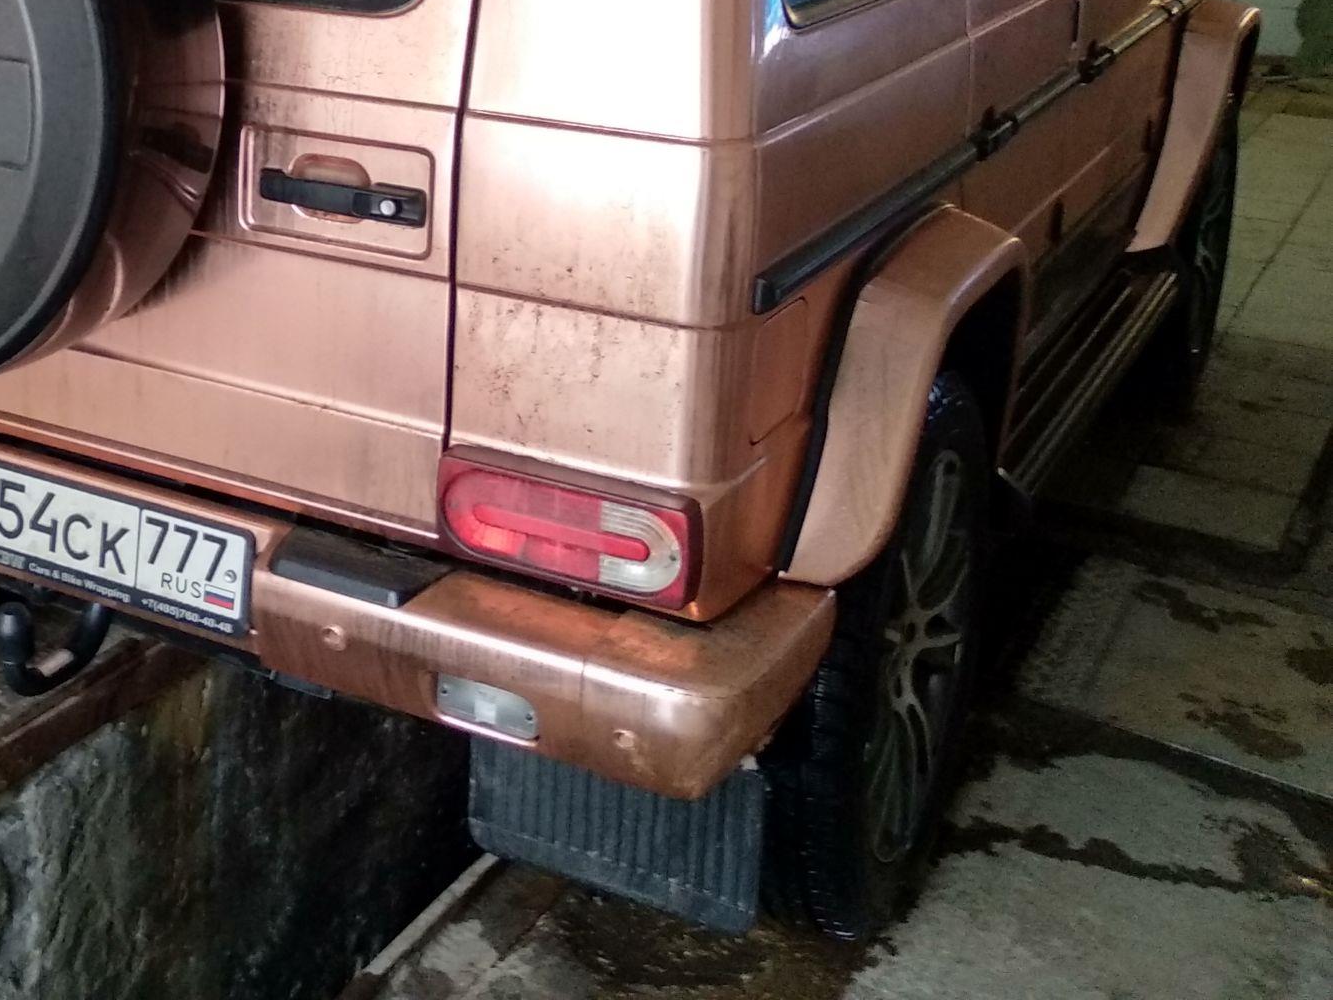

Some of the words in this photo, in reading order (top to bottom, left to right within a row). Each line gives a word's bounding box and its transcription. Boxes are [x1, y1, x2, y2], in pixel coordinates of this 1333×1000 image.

[145, 516, 228, 581] 777
[83, 579, 131, 603] Wrapping
[160, 572, 202, 599] RUS
